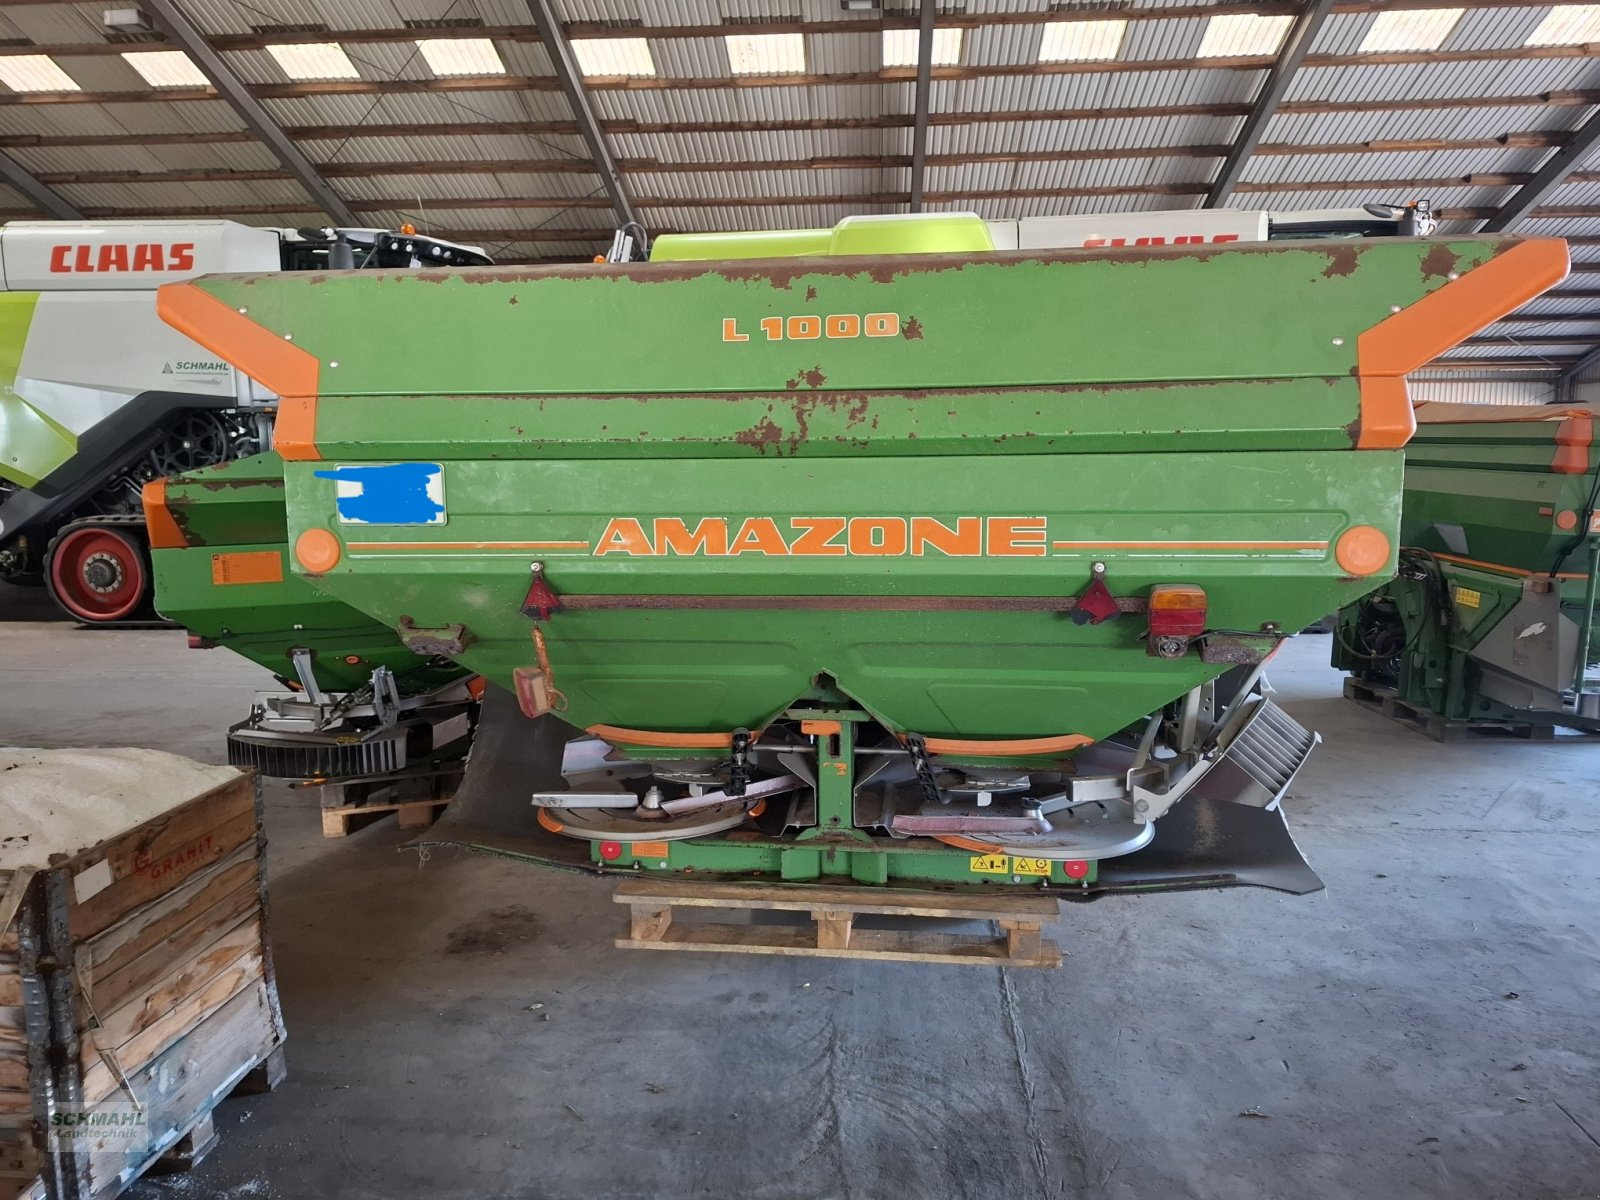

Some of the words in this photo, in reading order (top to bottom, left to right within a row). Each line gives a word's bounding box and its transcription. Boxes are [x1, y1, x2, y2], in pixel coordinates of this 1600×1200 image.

[50, 243, 194, 273] CLAAS
[722, 317, 750, 342] L
[760, 312, 900, 341] 1000
[175, 361, 229, 371] SCHMAHL
[592, 516, 1048, 557] AMAZONE
